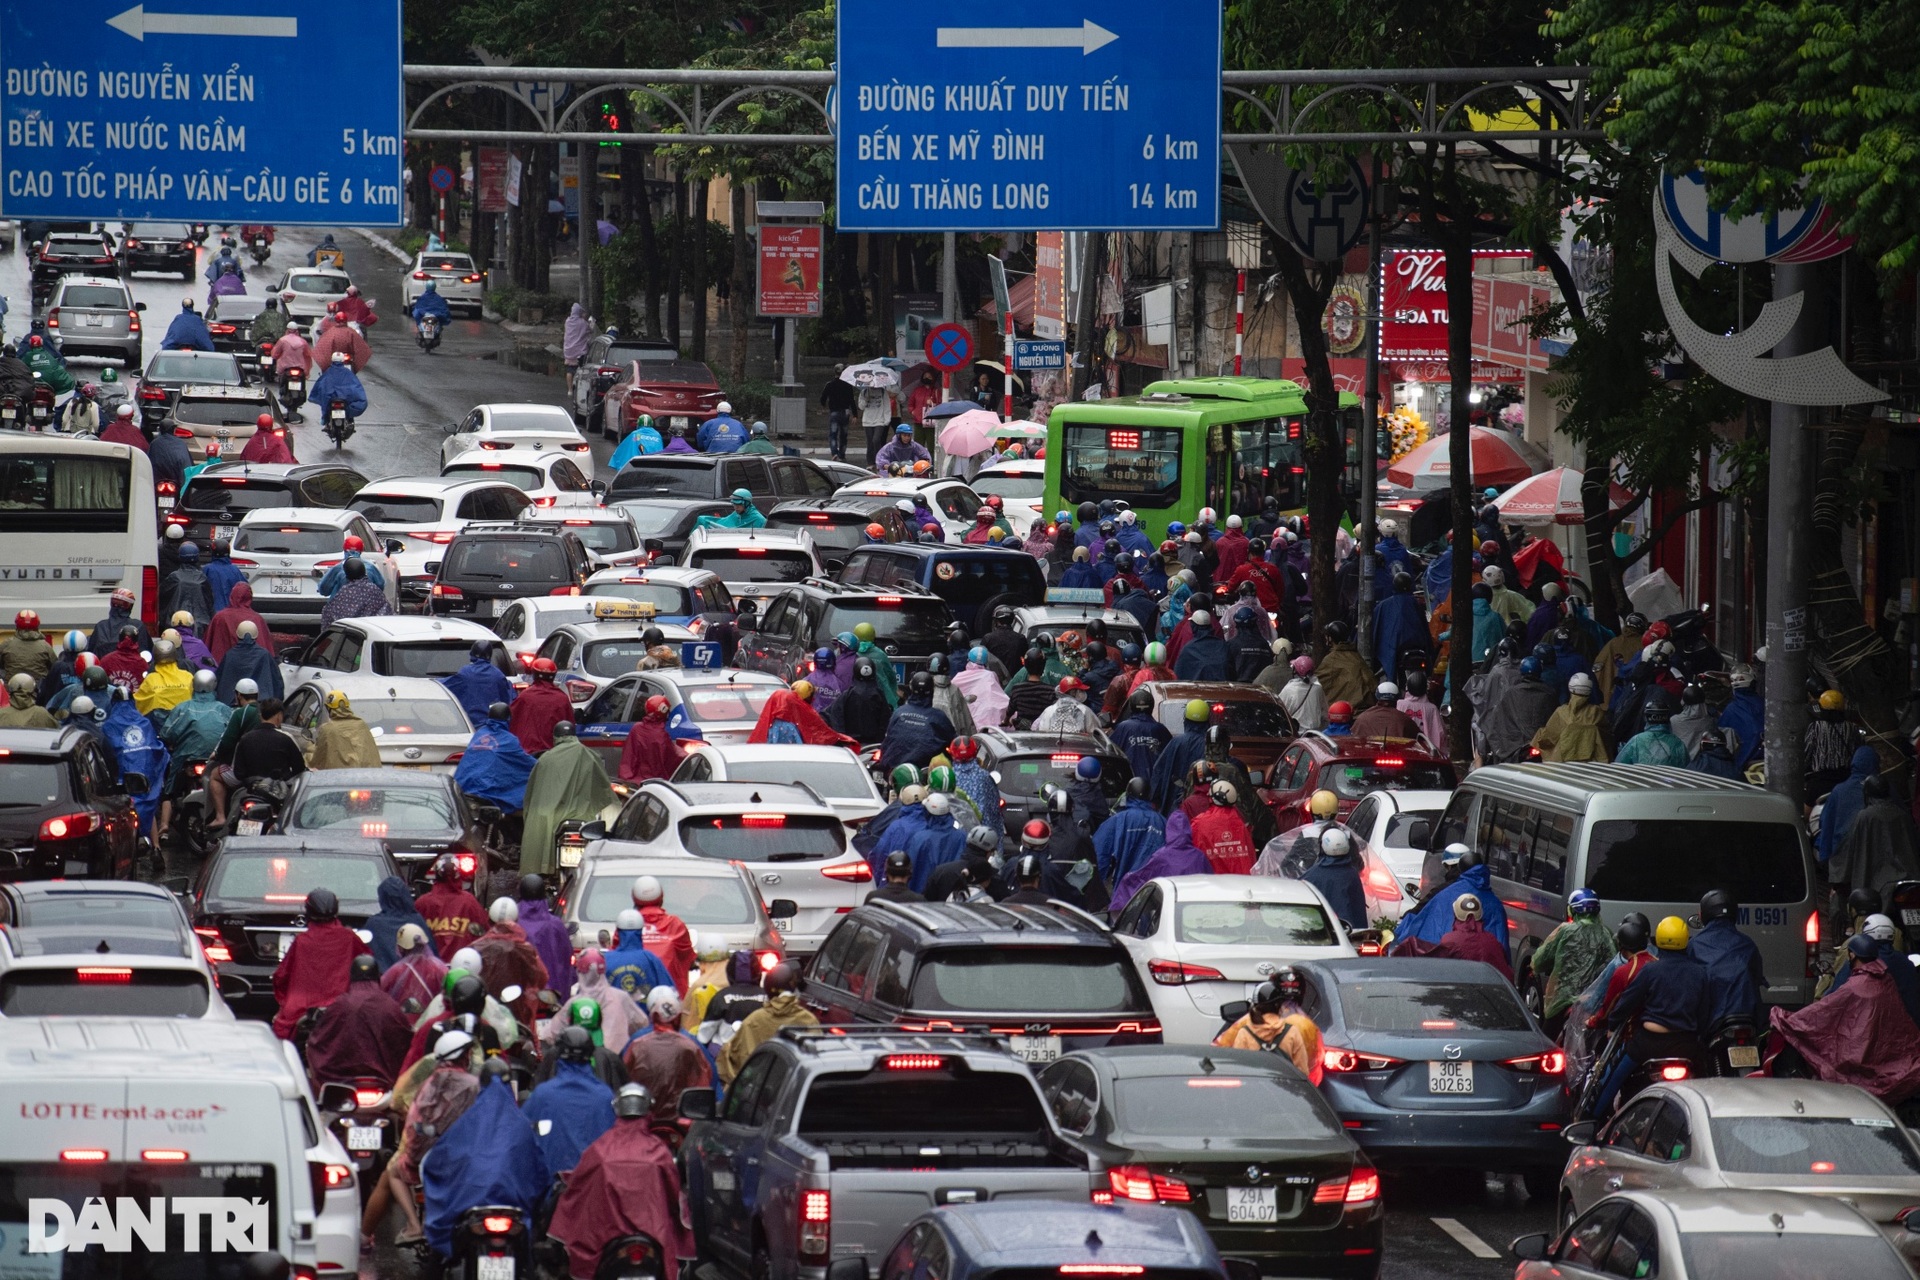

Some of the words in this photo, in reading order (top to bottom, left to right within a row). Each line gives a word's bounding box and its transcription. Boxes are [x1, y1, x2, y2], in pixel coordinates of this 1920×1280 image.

[6, 62, 88, 97] ĐƯỜNG
[99, 63, 190, 99] NGUYỄN
[202, 63, 255, 101] XIỂN
[858, 78, 935, 111] ĐƯỜNG
[945, 76, 1016, 111] KHUẤT
[1026, 85, 1068, 111] DUY
[1080, 75, 1129, 111] TIẾN
[8, 110, 54, 147] BẾN
[66, 121, 94, 148] XE
[106, 116, 168, 150] NƯỚC
[179, 116, 246, 152] NGẦM
[343, 129, 356, 155] 5
[363, 129, 397, 155] km
[858, 124, 900, 160] BẾN
[911, 134, 938, 160] XE
[949, 129, 980, 160] MỸ
[992, 128, 1044, 160] ĐÌNH
[1143, 134, 1154, 160] 6
[1165, 134, 1198, 160] km
[8, 169, 53, 198] CAO
[62, 161, 106, 199] TỐC
[115, 165, 173, 200] PHÁP
[183, 166, 286, 203] VÂN-CẦU
[294, 172, 329, 203] GIẼ
[340, 178, 352, 204] 6
[364, 178, 398, 205] km
[858, 175, 900, 210] CẦU
[910, 178, 982, 209] THĂNG
[992, 183, 1049, 209] LONG
[1129, 183, 1154, 209] 14
[1165, 182, 1197, 209] km
[778, 234, 800, 243] kickfit
[1395, 309, 1429, 324] HOA
[1032, 343, 1060, 351] ĐƯỜNG
[1110, 431, 1139, 449] 105
[1507, 501, 1556, 511] mobifone
[67, 556, 94, 564] SUPER
[274, 585, 298, 593] 282.34
[694, 645, 713, 665] G7
[1754, 907, 1788, 925] 9591
[427, 917, 470, 933] MAST
[1440, 1063, 1463, 1077] 30E
[1431, 1077, 1473, 1092] 302.63
[20, 1103, 97, 1119] LOTTE
[102, 1104, 207, 1120] rent-a-car
[167, 1123, 207, 1134] VINA
[1240, 1188, 1265, 1204] 29A
[1229, 1205, 1275, 1220] 604.07
